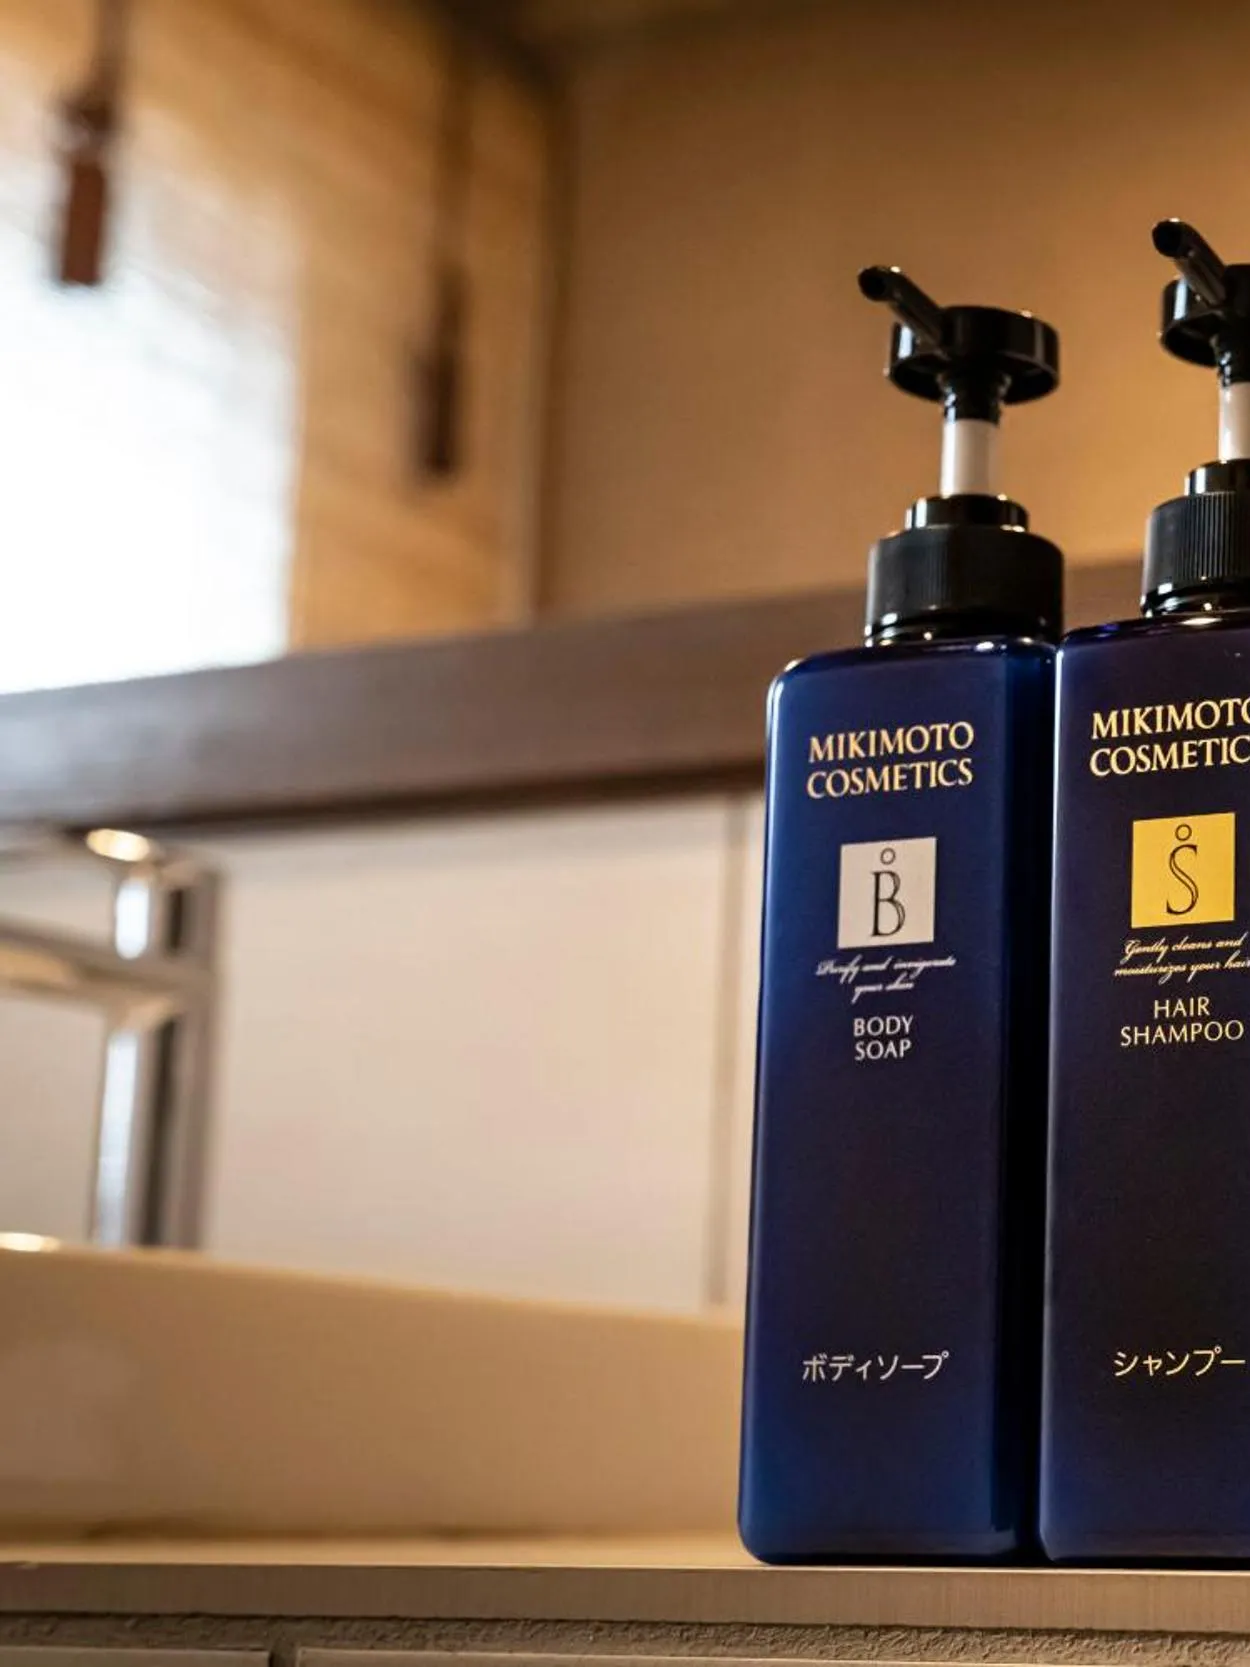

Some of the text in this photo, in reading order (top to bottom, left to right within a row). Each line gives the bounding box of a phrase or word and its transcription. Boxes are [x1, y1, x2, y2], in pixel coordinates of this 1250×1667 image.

[808, 721, 975, 763] MIKIMOTO
[806, 757, 974, 799] COSMETICS
[1119, 936, 1169, 965] Gently
[1215, 931, 1249, 948] and
[1186, 960, 1221, 983] your
[1153, 995, 1211, 1020] HAIR
[853, 1015, 914, 1038] BODY
[1120, 1019, 1245, 1047] SHAMPOO
[854, 1038, 912, 1061] SOAP
[802, 1350, 950, 1382] ボディソープ
[1113, 1345, 1246, 1377] シャンプー
